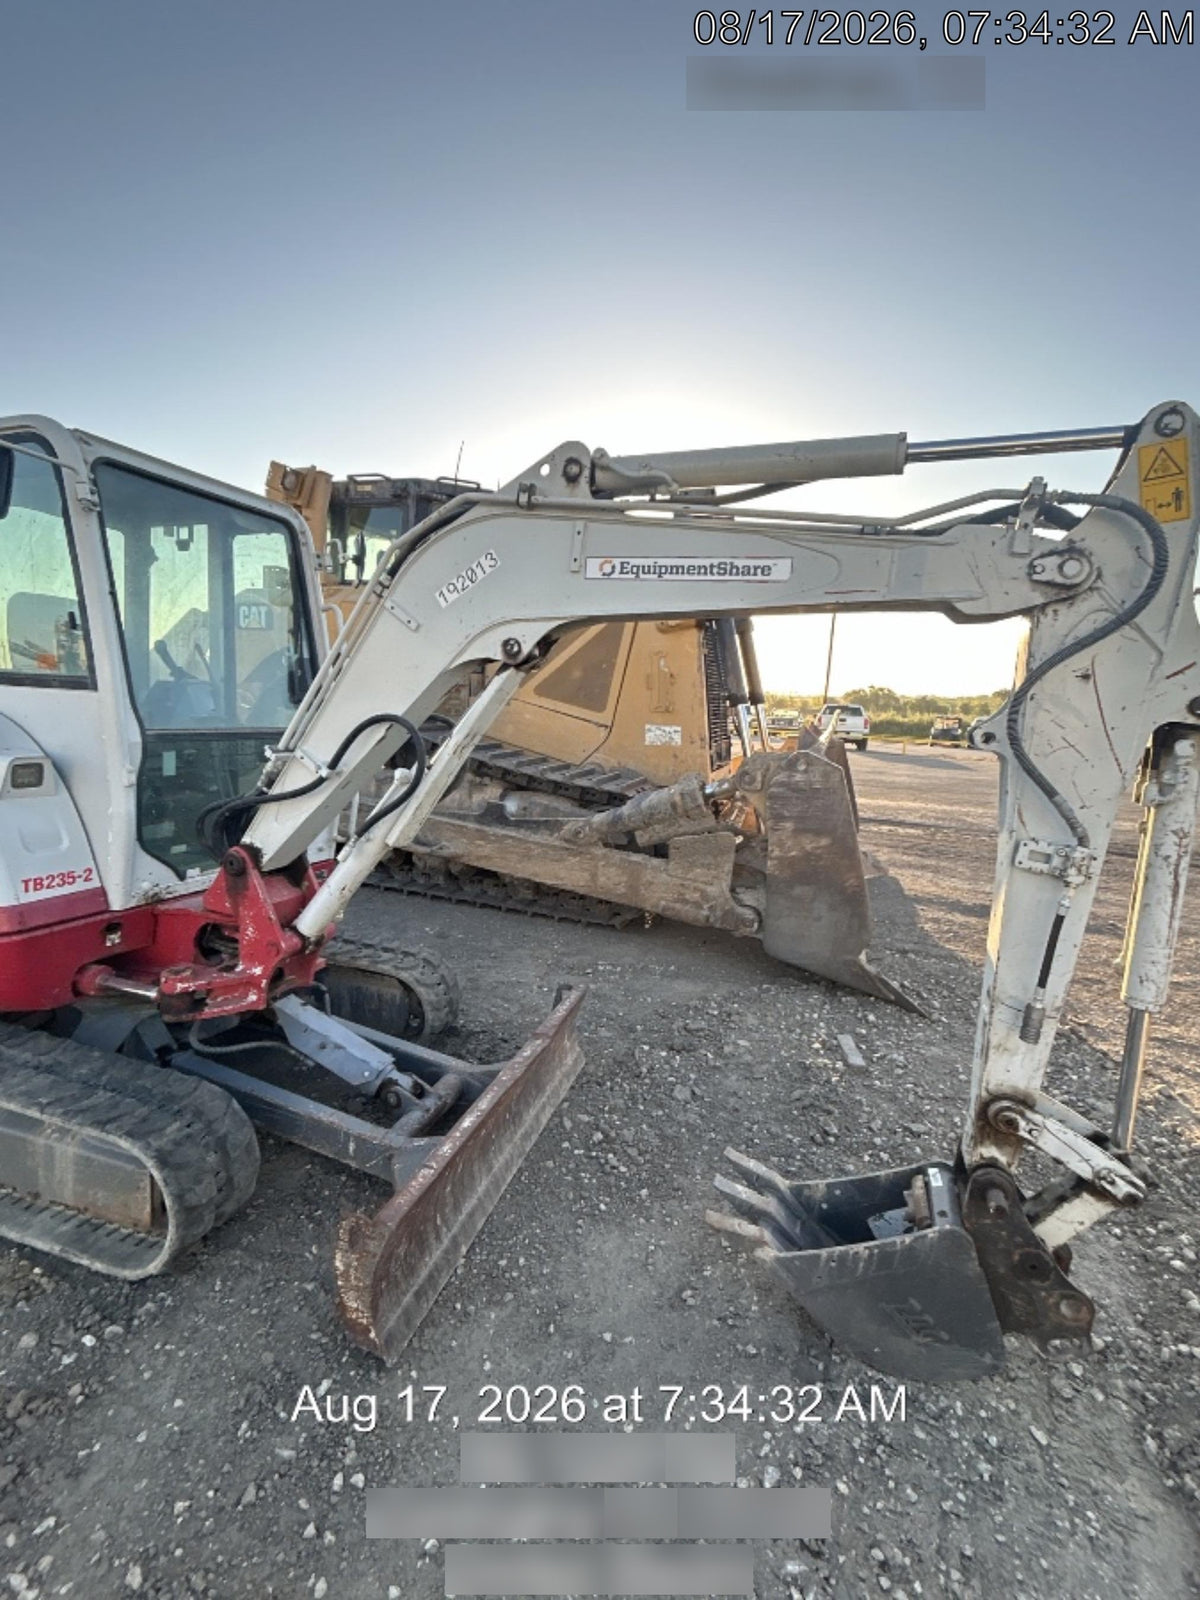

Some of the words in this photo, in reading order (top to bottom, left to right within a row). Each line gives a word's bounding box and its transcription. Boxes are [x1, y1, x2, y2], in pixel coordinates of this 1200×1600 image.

[438, 552, 498, 604] 192013
[619, 560, 772, 578] EquipmentShare
[239, 605, 269, 629] CAT
[21, 867, 93, 893] TB235-2
